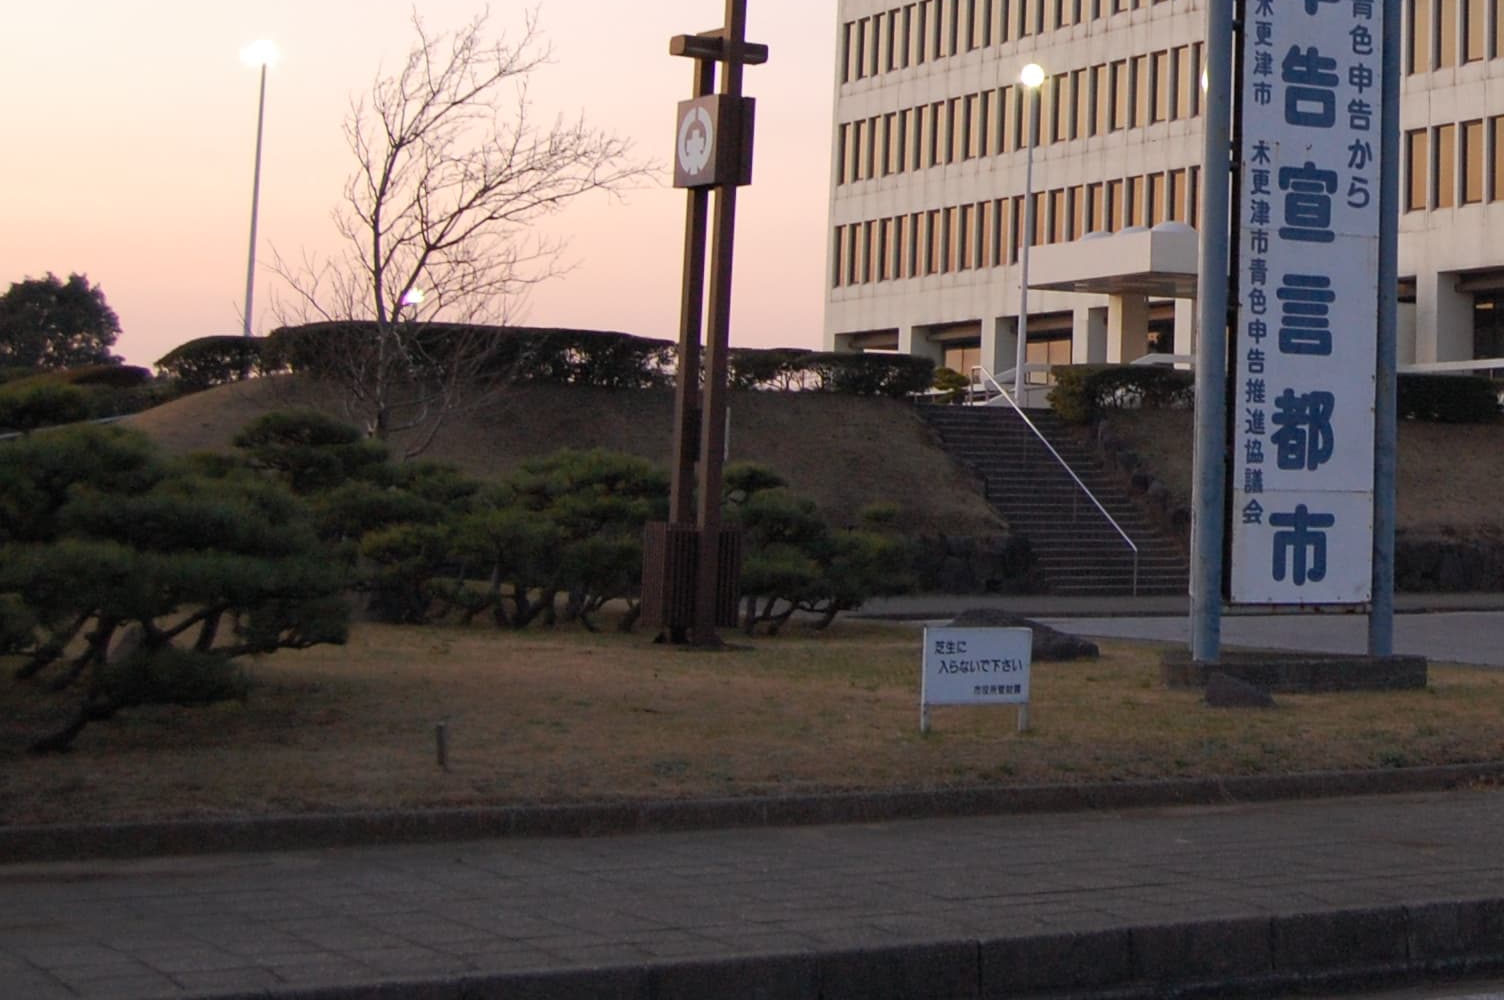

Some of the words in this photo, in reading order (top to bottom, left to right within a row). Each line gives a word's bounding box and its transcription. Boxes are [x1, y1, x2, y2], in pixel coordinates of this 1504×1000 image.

[1241, 139, 1272, 525] 木更津市青色申告推進協議会
[935, 640, 967, 655] 芝生に
[938, 659, 1023, 674] 入らないで下さい
